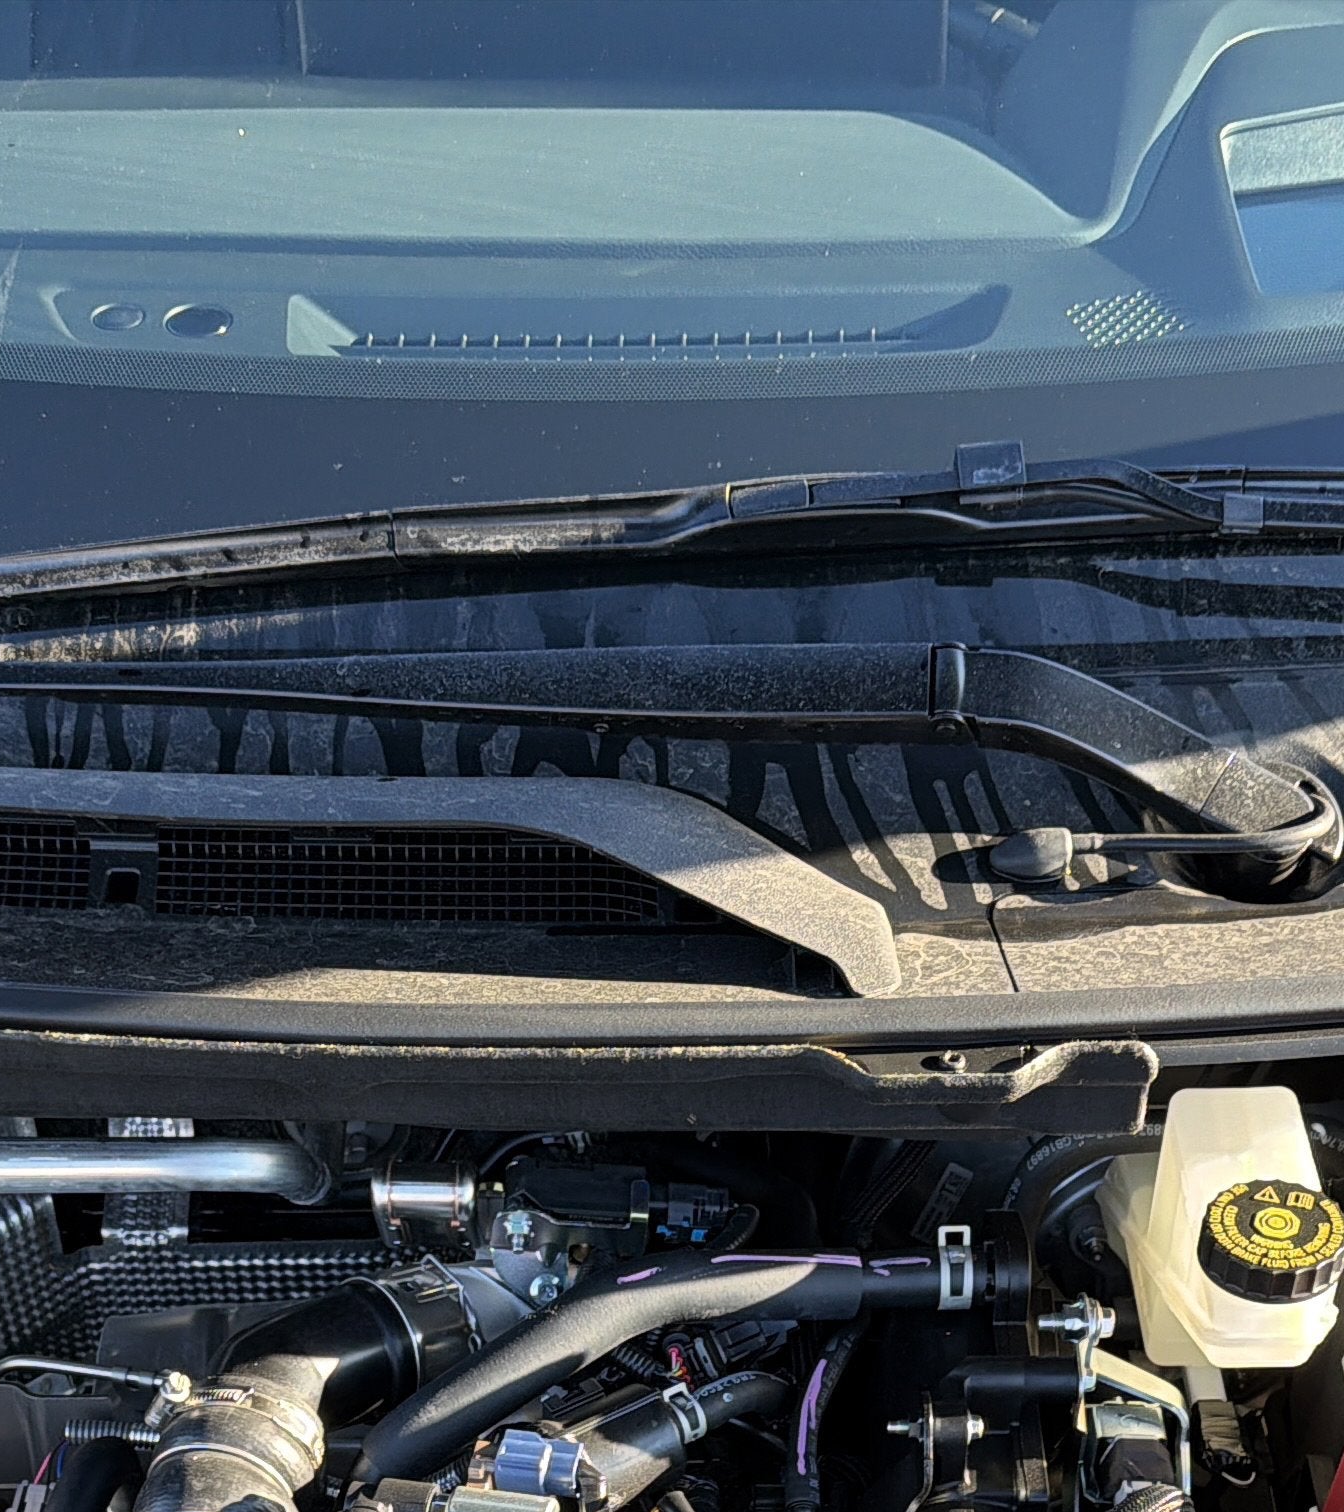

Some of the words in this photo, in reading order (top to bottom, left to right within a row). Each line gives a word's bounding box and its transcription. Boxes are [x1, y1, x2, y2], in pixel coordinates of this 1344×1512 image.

[1230, 1245, 1261, 1265] BRAKE
[1260, 1257, 1290, 1269] FLUID
[1246, 1243, 1268, 1255] CAP
